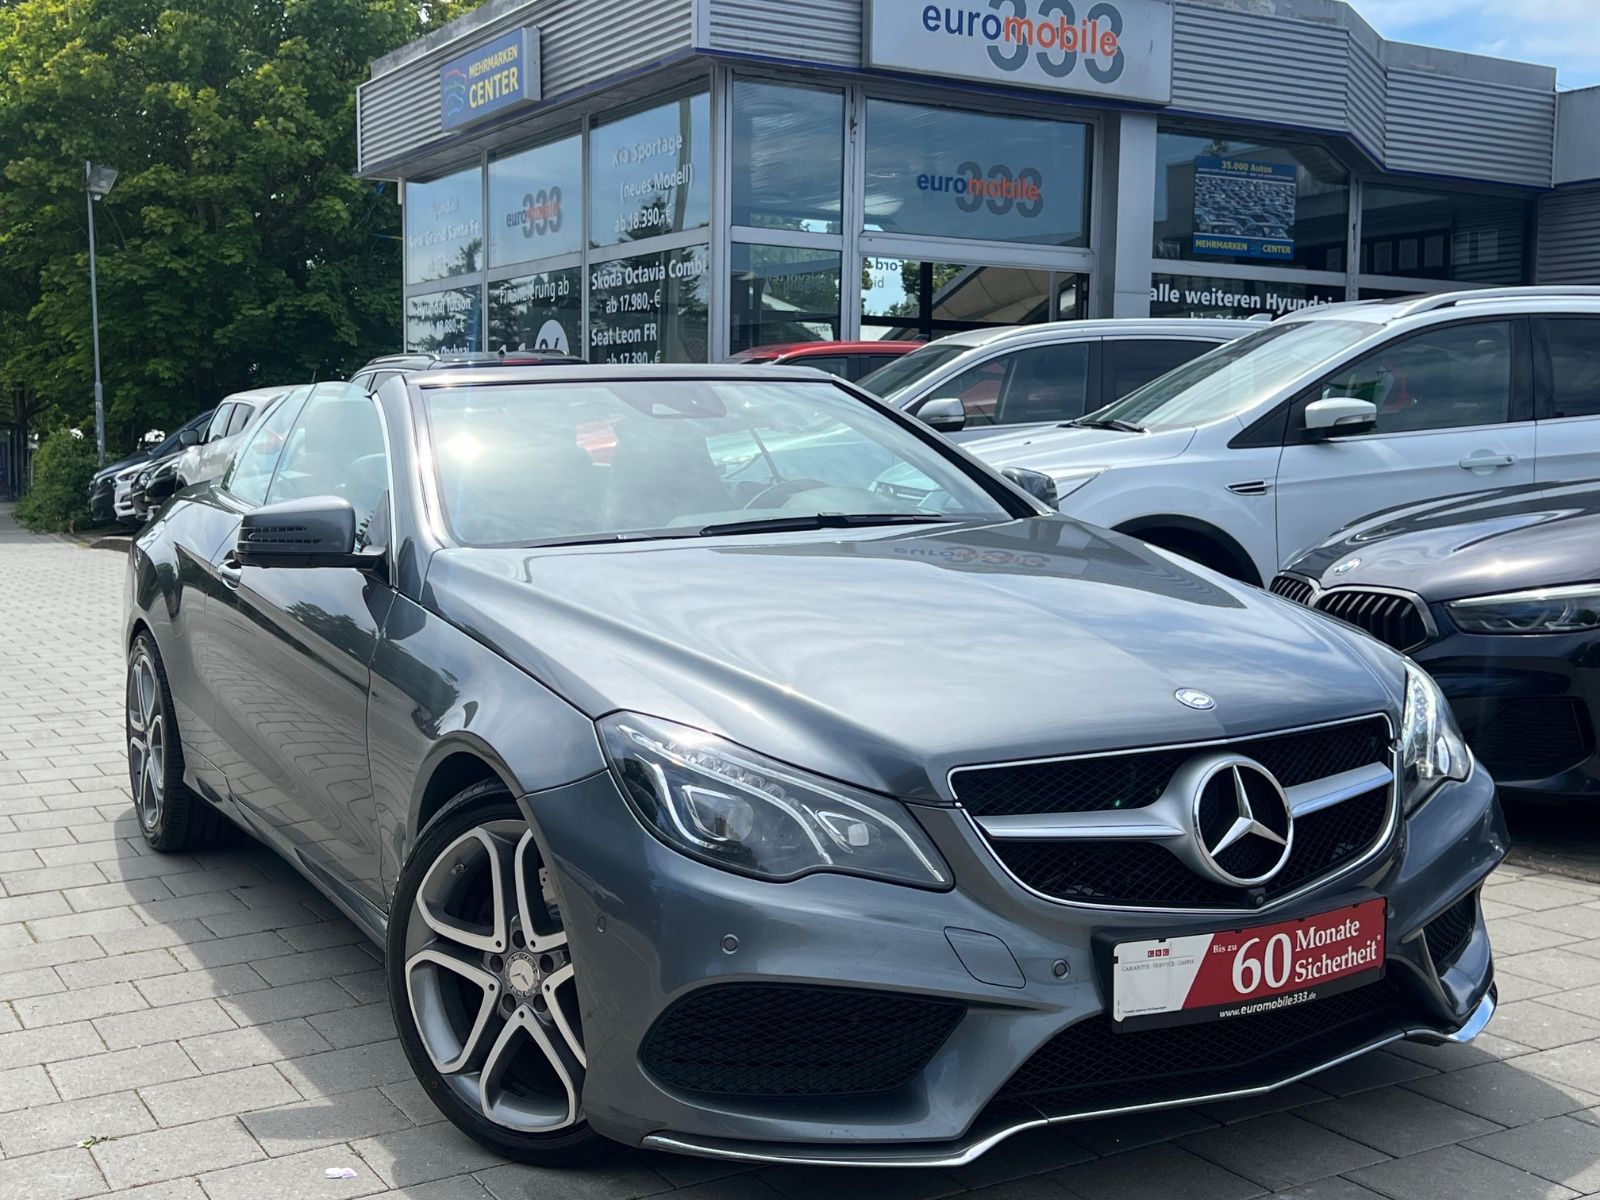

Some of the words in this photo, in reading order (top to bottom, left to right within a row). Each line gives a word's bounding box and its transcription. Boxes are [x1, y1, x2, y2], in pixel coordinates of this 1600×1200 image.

[922, 5, 1118, 57] euromobile
[469, 44, 518, 79] MEHRMARKEN
[469, 66, 519, 108] CENTER
[612, 147, 629, 168] Kia
[632, 134, 683, 164] Sportage
[1222, 160, 1248, 171] 35.000
[1250, 164, 1272, 174] Autos
[620, 179, 652, 203] (neues
[654, 163, 693, 191] Modell)
[917, 174, 1040, 200] euromobile
[955, 161, 1044, 218] 333
[614, 213, 626, 233] ab
[1195, 240, 1248, 251] MEHRMARKEN
[1263, 244, 1291, 254] CENTER
[625, 261, 665, 284] Octavia
[668, 256, 706, 279] Combi
[558, 274, 570, 295] ab
[1150, 284, 1180, 303] alle
[1185, 288, 1261, 309] weiteren
[606, 295, 618, 314] ab
[620, 289, 661, 312] 17.980,-€
[591, 327, 613, 346] Seat
[616, 326, 641, 344] Leon
[644, 323, 657, 341] FR
[620, 350, 661, 364] 17390-€
[1295, 919, 1360, 952] Monate
[1121, 963, 1150, 972] GARANTIE
[1213, 944, 1226, 953] Bis
[1227, 943, 1237, 952] zu
[1232, 933, 1292, 994] 60
[1295, 940, 1377, 983] Sicherheit
[1219, 991, 1316, 1018] www.euromobile333.de
